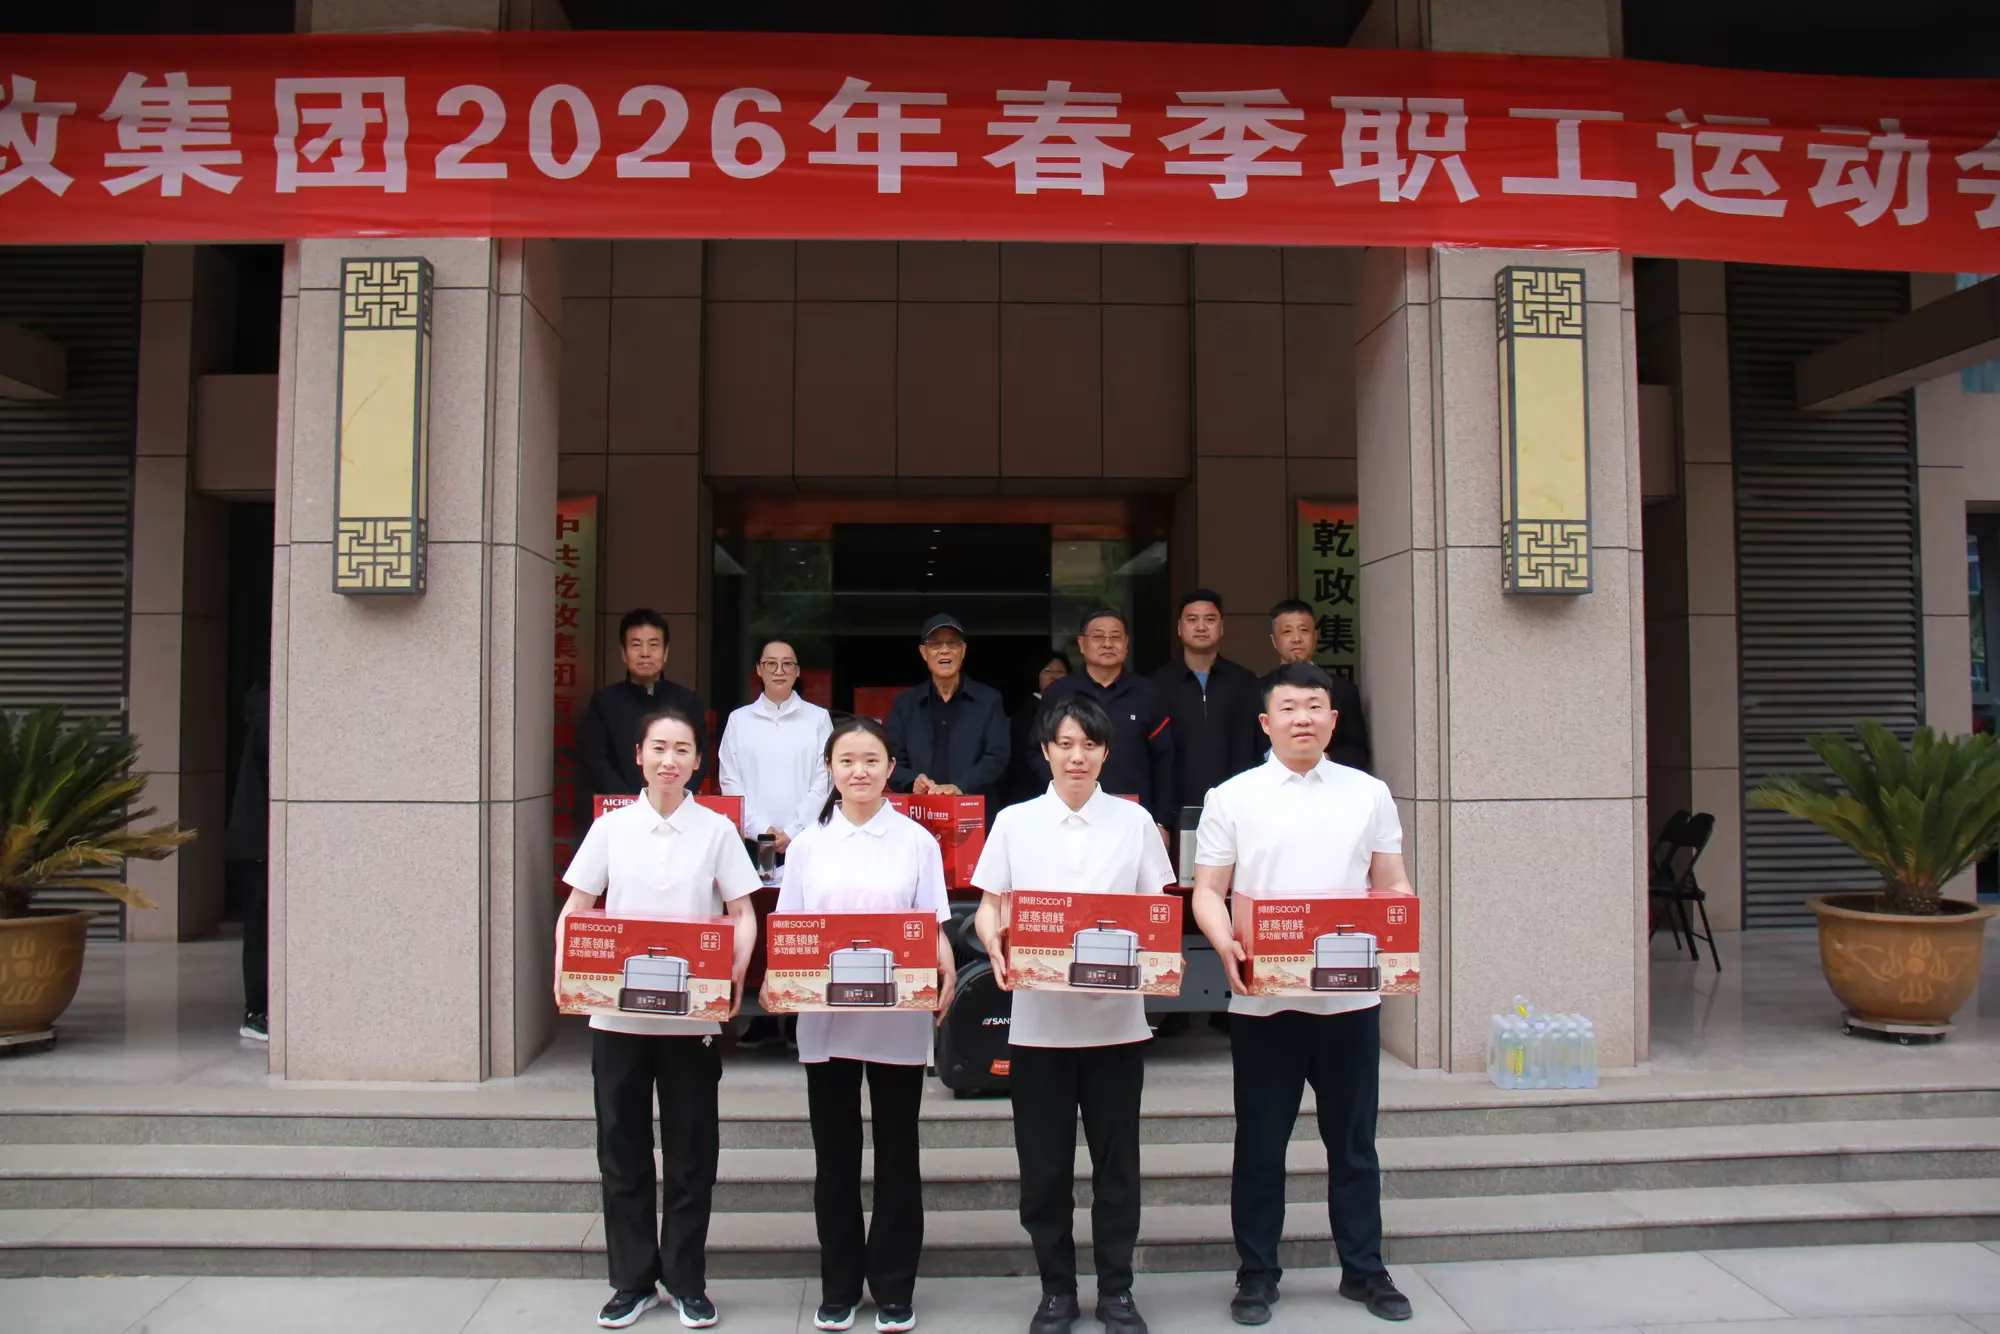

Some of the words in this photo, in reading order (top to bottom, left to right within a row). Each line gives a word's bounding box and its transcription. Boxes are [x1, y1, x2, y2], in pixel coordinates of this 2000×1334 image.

[1018, 910, 1065, 923] 速蒸锁鲜
[1258, 919, 1304, 931] 速蒸锁鲜
[569, 936, 616, 950] 速蒸锁鲜
[773, 934, 819, 946] 速蒸锁鲜
[992, 1017, 1012, 1025] SAN
